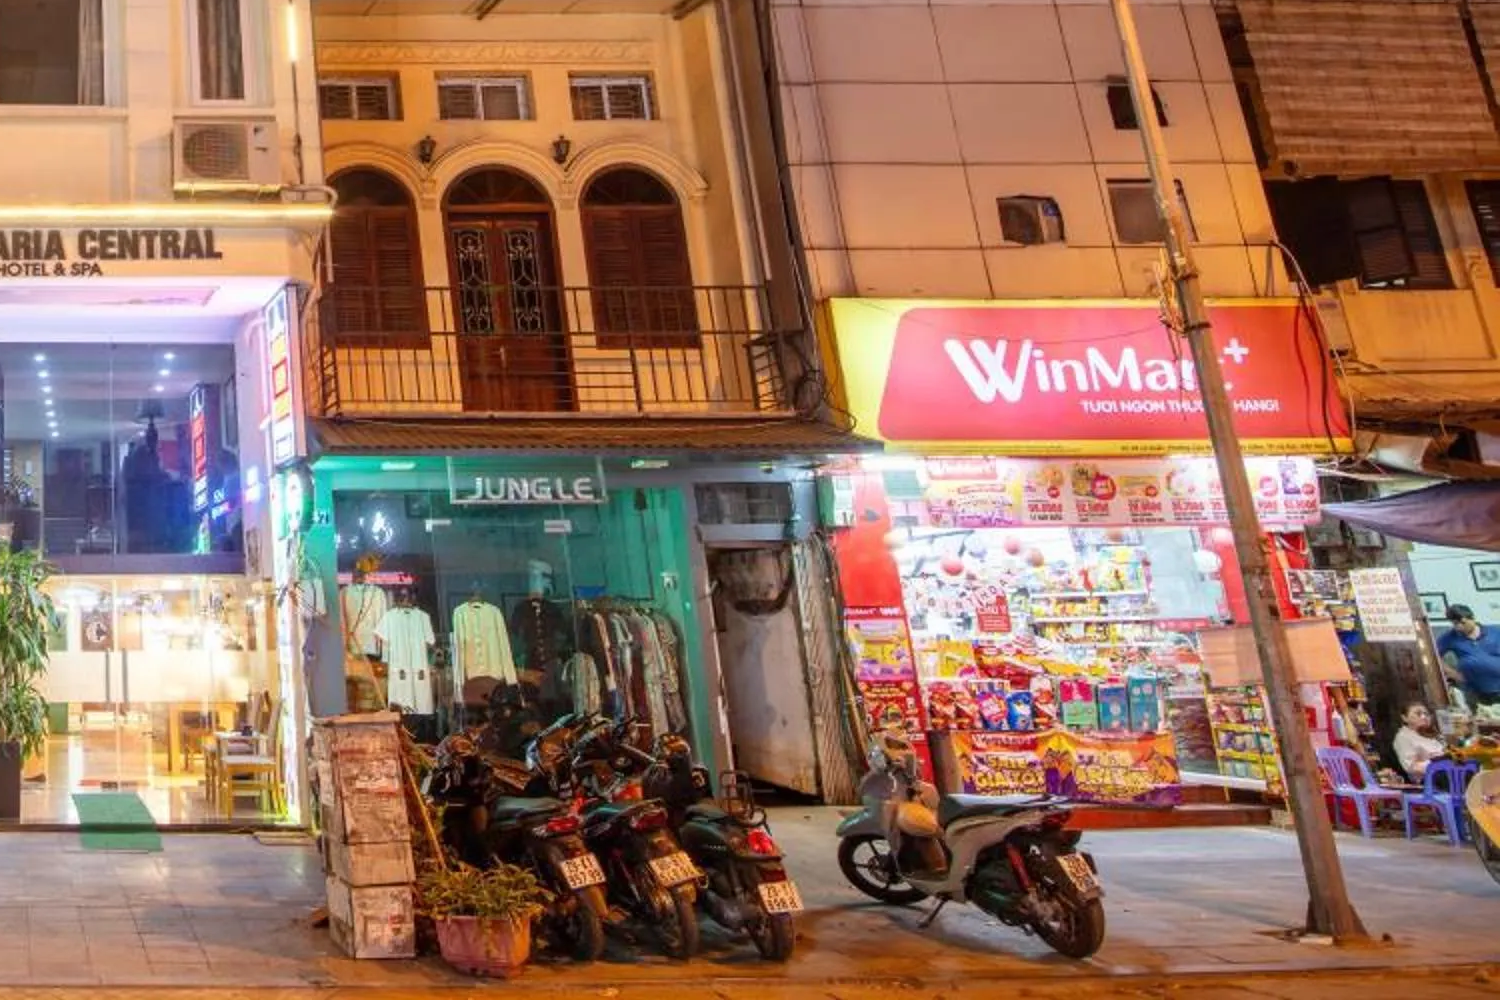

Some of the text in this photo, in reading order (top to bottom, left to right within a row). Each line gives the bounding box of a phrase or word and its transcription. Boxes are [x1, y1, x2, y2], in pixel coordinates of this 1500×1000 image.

[77, 228, 224, 261] CENTRAL
[53, 263, 66, 277] &
[70, 262, 103, 276] SPA
[466, 477, 595, 500] JUNGLE
